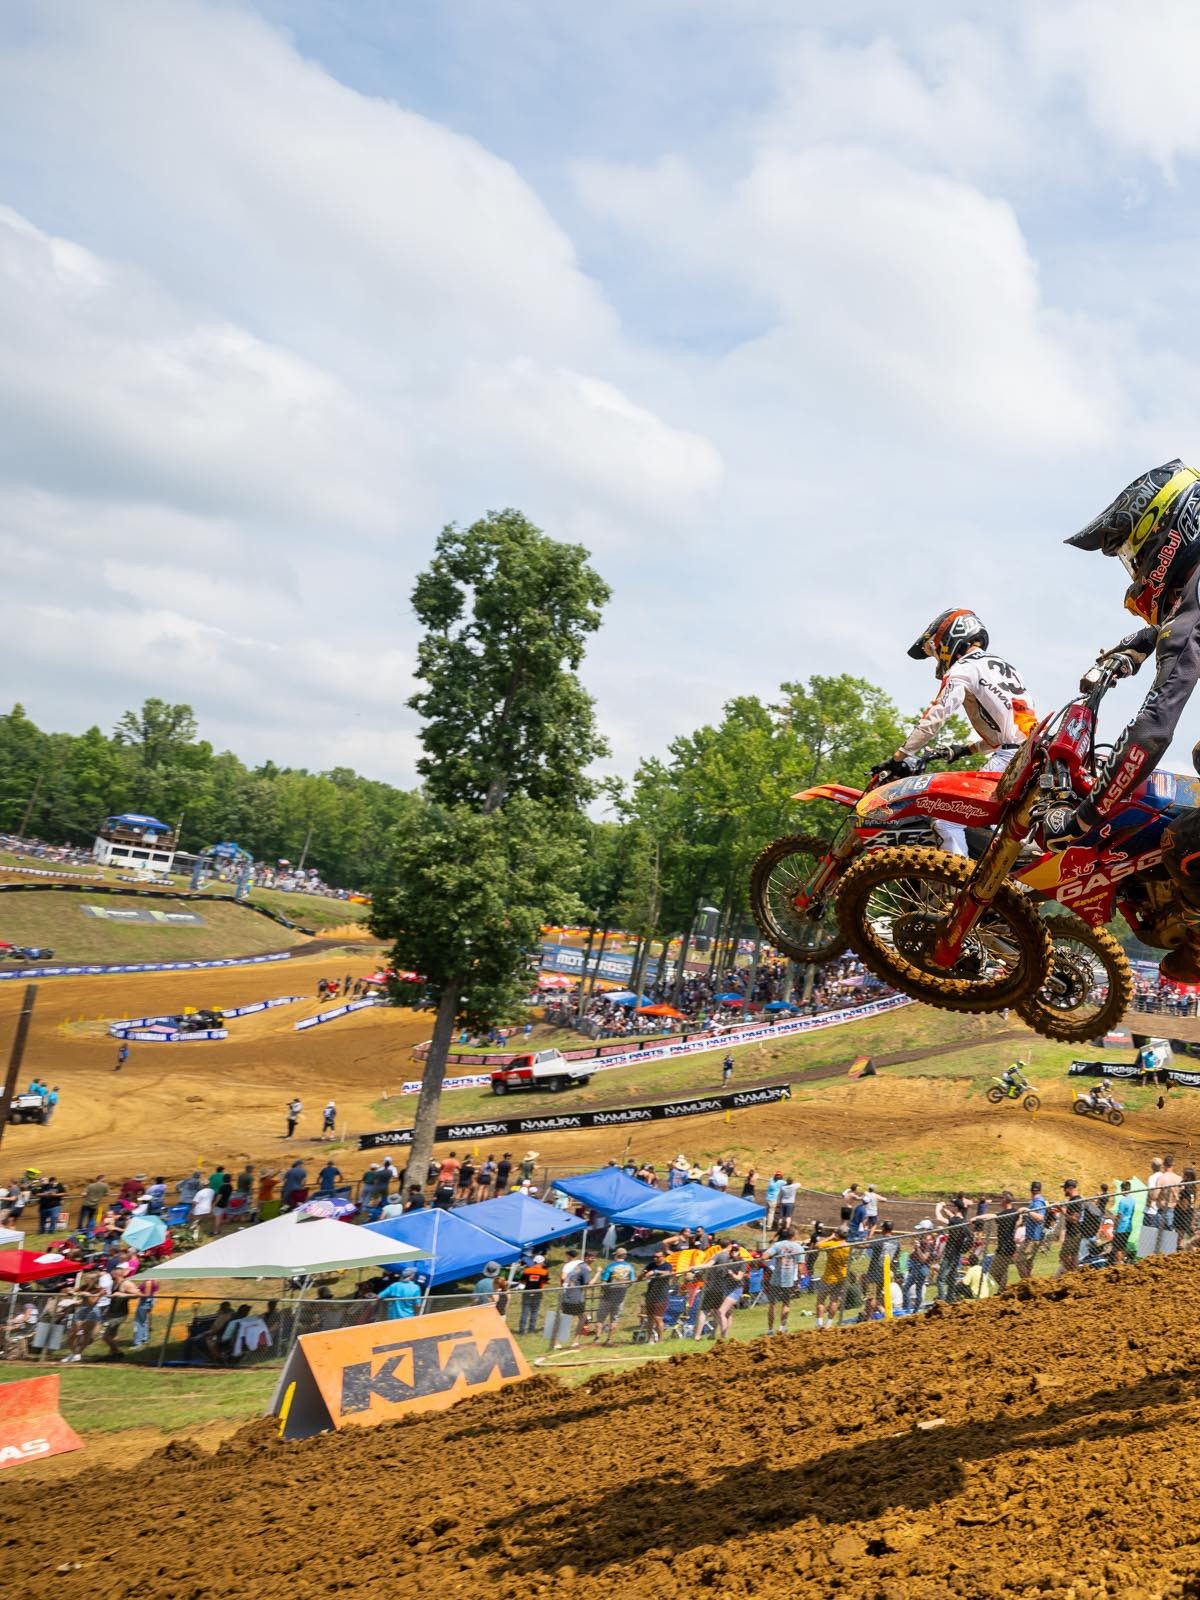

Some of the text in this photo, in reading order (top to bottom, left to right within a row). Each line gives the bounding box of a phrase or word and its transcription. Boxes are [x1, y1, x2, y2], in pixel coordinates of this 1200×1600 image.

[1129, 481, 1158, 516] POW!
[915, 797, 936, 814] Troy
[950, 801, 990, 819] Designs
[629, 1049, 664, 1060] PARTS
[742, 1028, 775, 1039] PARTS
[777, 1020, 811, 1032] PARTS
[448, 1123, 508, 1137] NAMURA
[520, 1116, 581, 1130] NAMURA
[593, 1109, 652, 1123] NAMURA
[664, 1100, 722, 1116] NAMURA
[340, 1329, 521, 1417] KTM
